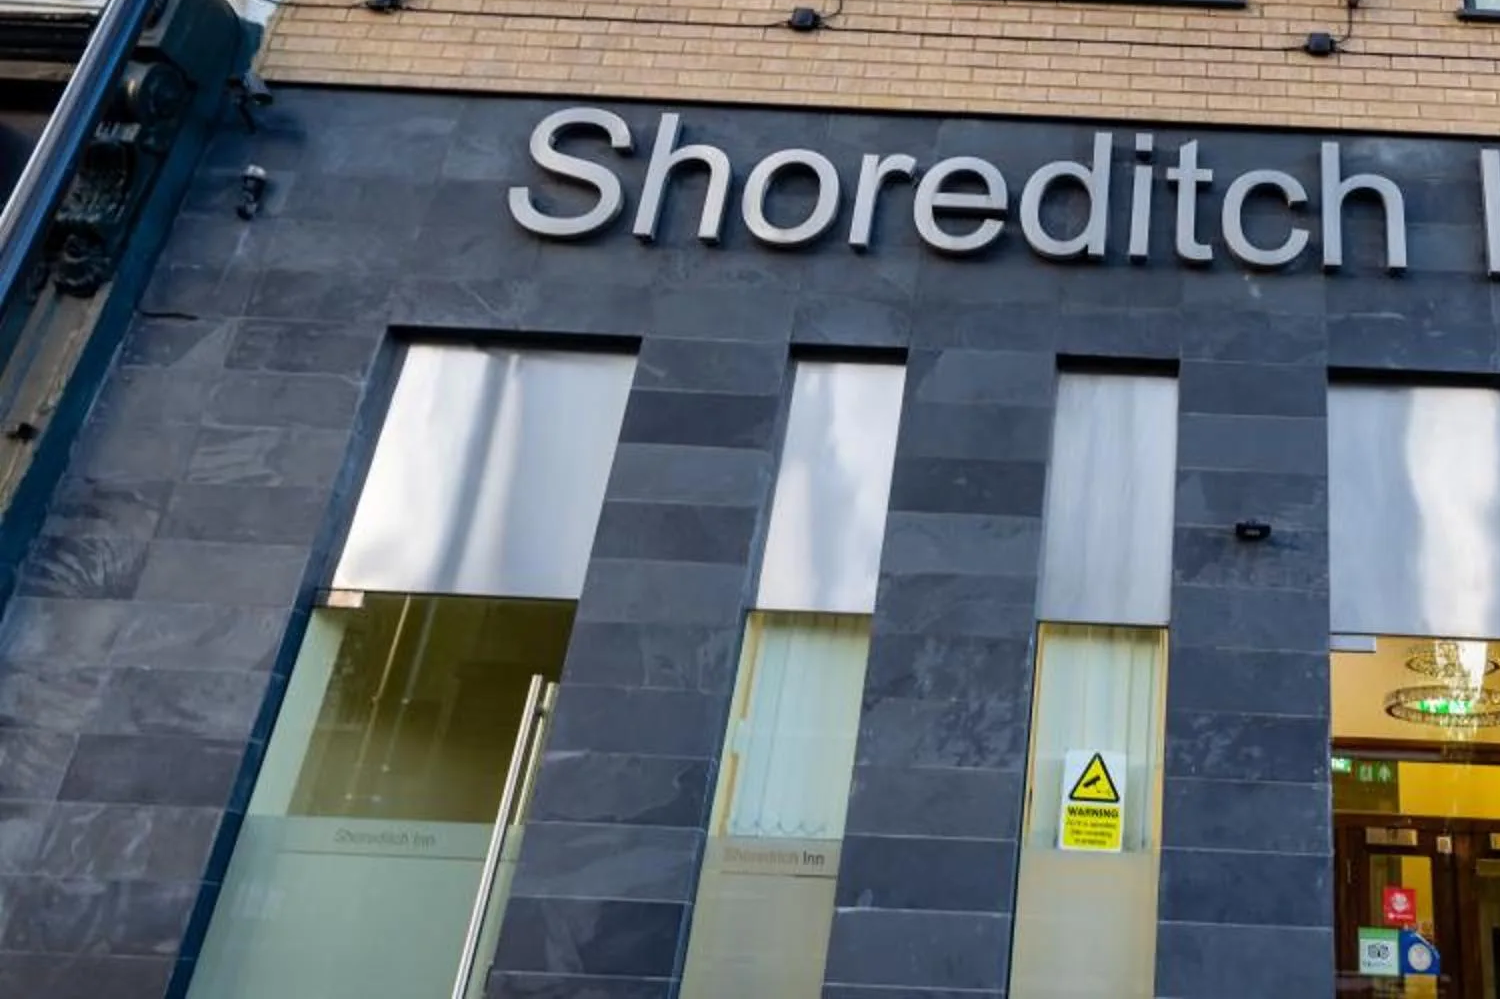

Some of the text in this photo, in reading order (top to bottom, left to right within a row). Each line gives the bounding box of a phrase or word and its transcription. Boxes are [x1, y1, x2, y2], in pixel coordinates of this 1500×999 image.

[508, 107, 1408, 273] Shoreditch
[1067, 805, 1119, 818] WARNING
[802, 850, 825, 866] Inn
